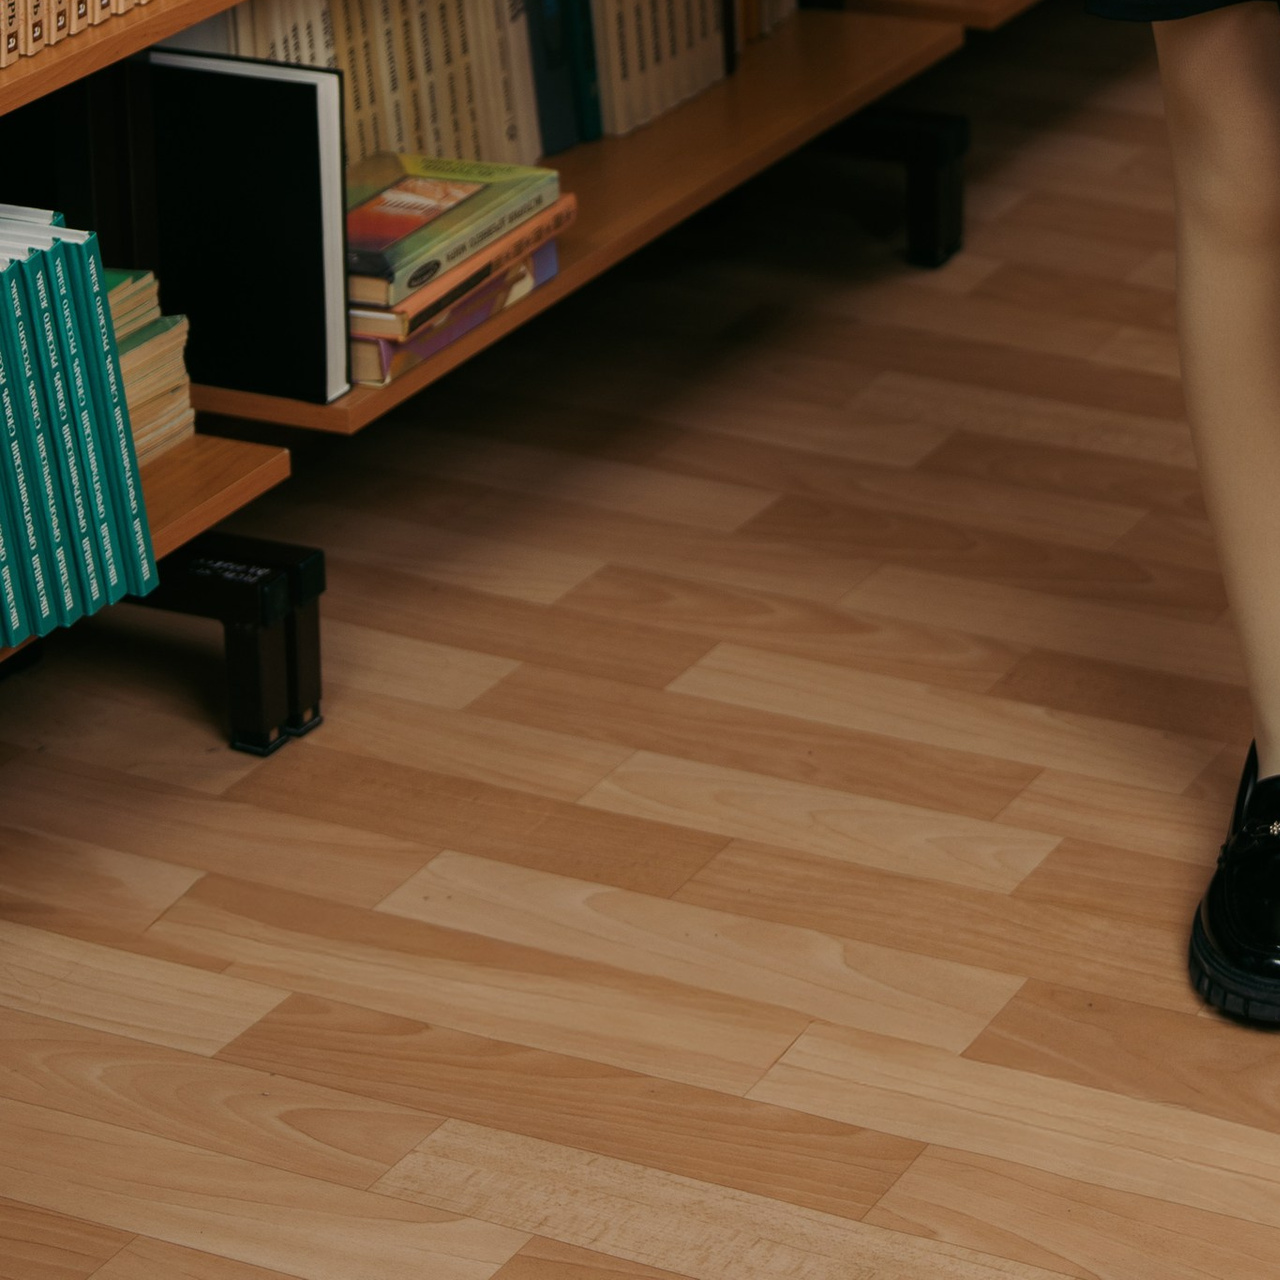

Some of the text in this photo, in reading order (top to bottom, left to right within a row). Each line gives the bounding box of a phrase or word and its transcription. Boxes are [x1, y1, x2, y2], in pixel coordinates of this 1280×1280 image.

[1, 386, 50, 619] ШКОЛЬНЫЙ ОРФОГРАФИЧЕСКИЙ СЛОВАРЬ
[10, 278, 74, 611] ШКОЛЬНЫЙ ОРФОГРАФИЧЕСКИЙ СЛОВАРЬ РУССКОГО ЯЗЫКА
[36, 270, 100, 602] ШКОЛЬНЫЙ ОРФОГРАФИЧЕСКИЙ СЛОВАРЬ РУССКОГО ЯЗЫКА
[54, 256, 119, 587] ШКОЛЬНЫЙ ОРФОГРАФИЧЕСКИЙ СЛОВАРЬ РУССКОГО ЯЗЫКА
[87, 253, 151, 582] ШКОЛЬНЫЙ ОРФОГРАФИЧЕСКИЙ СЛОВАРЬ РУССКОГО ЯЗЫКА
